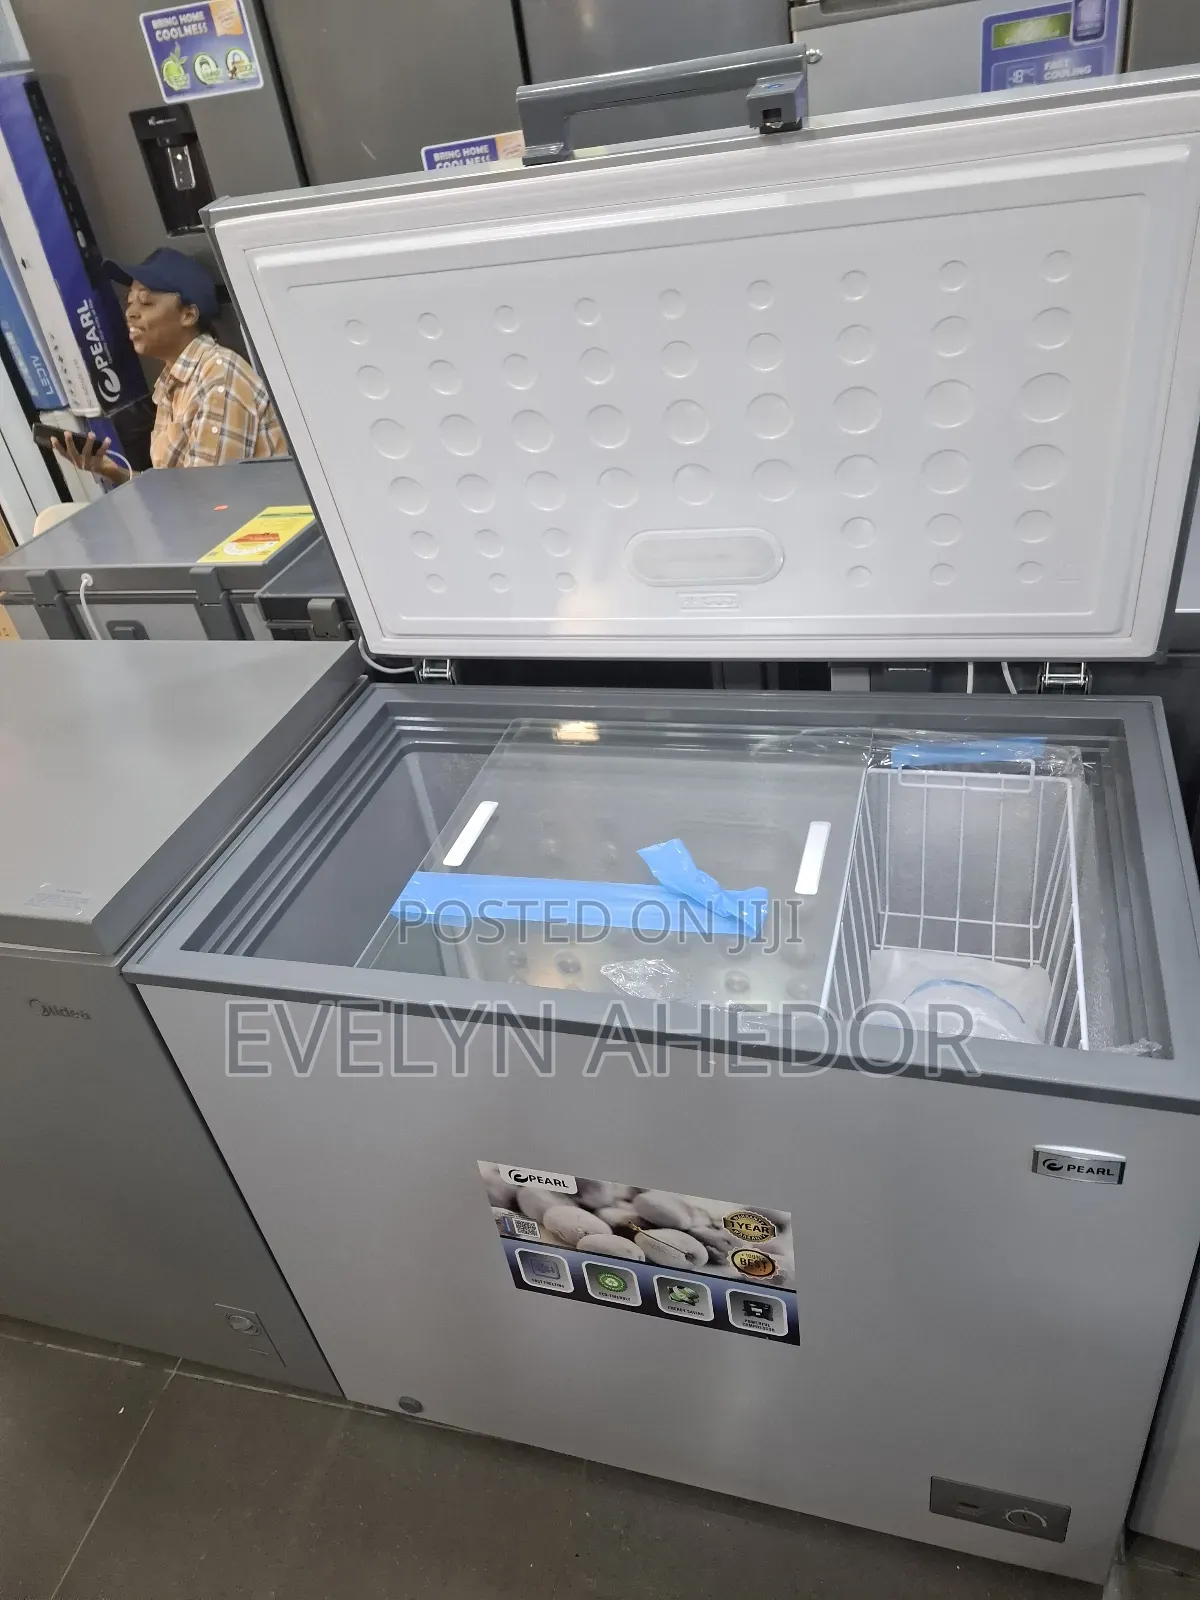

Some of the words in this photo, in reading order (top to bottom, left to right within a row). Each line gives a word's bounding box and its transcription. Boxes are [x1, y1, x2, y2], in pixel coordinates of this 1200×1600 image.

[151, 16, 179, 29] BRING
[179, 11, 205, 24] HOME
[155, 22, 208, 42] COOLNESS
[433, 150, 462, 161] BRING
[462, 144, 490, 157] HOME
[77, 299, 109, 370] PEARL
[1066, 1163, 1115, 1177] PEARL
[528, 1174, 570, 1189] PEARL
